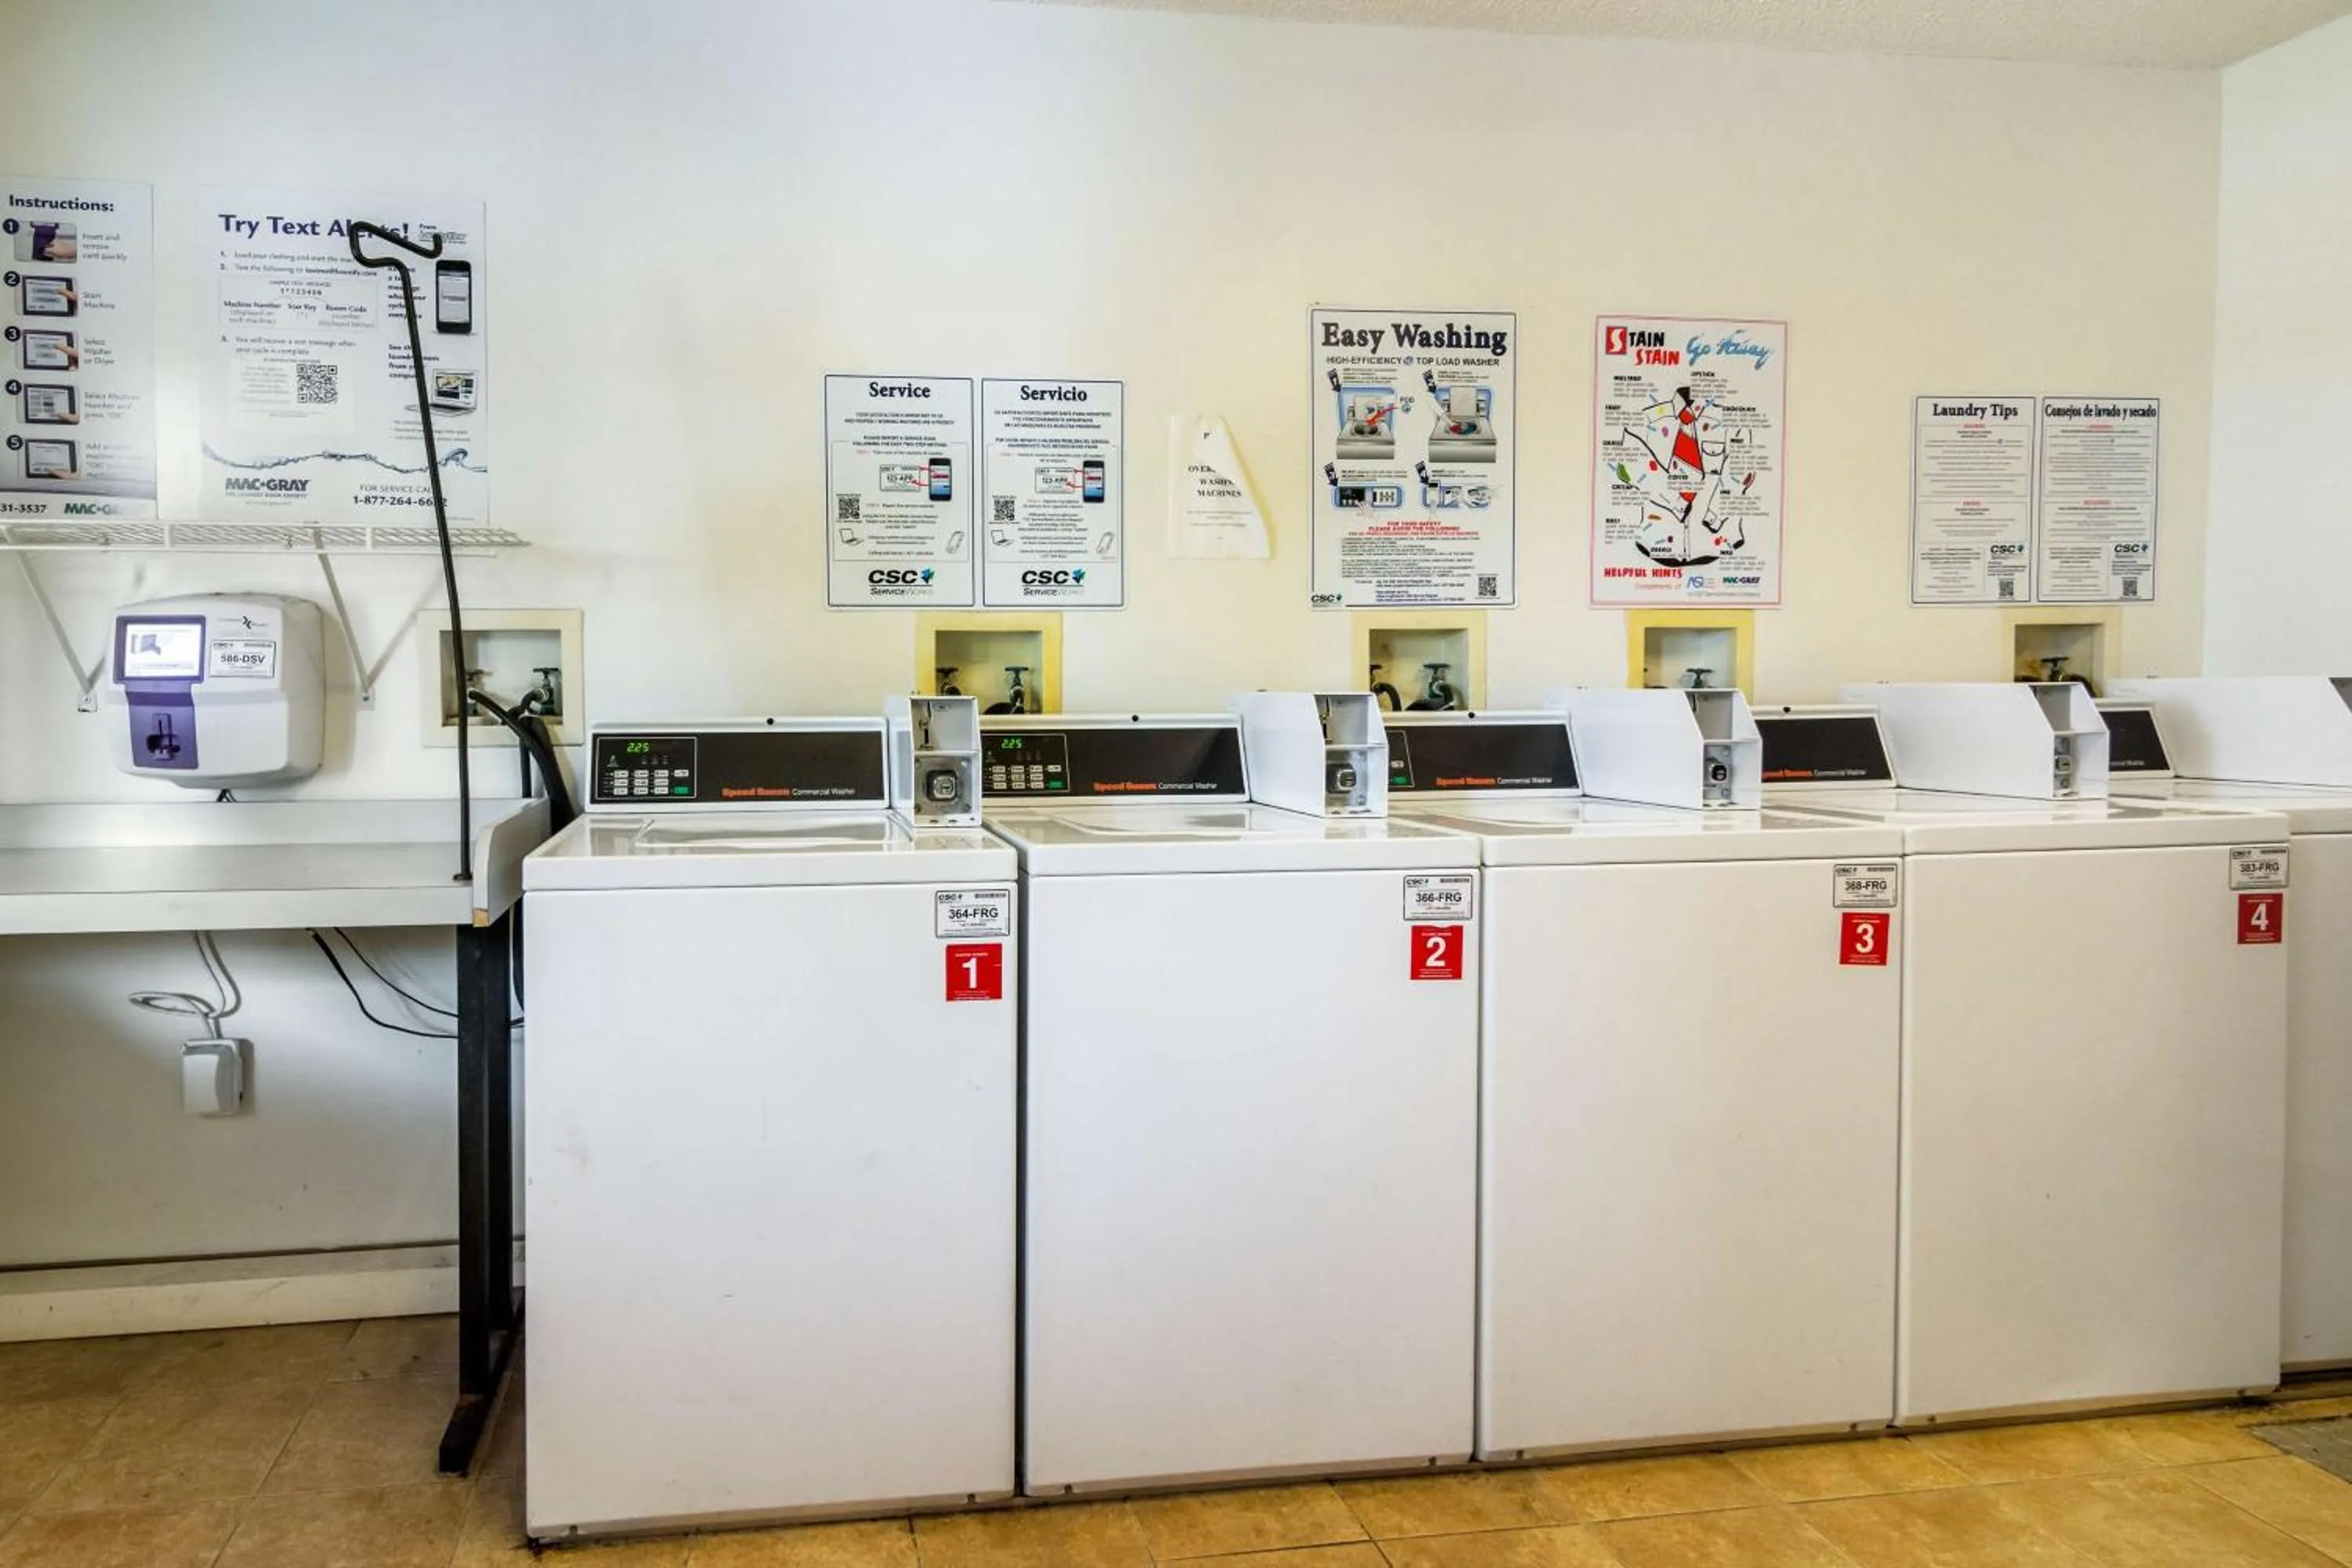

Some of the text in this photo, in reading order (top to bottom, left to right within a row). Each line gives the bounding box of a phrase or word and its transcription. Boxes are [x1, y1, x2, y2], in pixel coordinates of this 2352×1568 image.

[9, 194, 114, 212] Instructions:
[219, 214, 260, 238] Try
[267, 216, 320, 236] Text
[1321, 322, 1508, 357] Easy Washing
[1327, 356, 1402, 365] HIGH-EFFICIENCY
[1417, 357, 1434, 365] TOP
[1436, 358, 1460, 366] LOAD
[1634, 348, 1680, 366] STAIN
[869, 382, 931, 398] Service
[1020, 385, 1087, 401] Servicio
[1933, 404, 2018, 419] Laundry Tips
[2045, 405, 2156, 420] Consejos de lavado y secado
[353, 495, 448, 507] 1-877-264-662
[1991, 545, 2016, 554] CSC
[2114, 544, 2140, 553] CSC
[869, 569, 918, 584] CSC
[1022, 570, 1069, 584] CSC
[1604, 568, 1682, 579] HELPFUL HINTS
[1311, 593, 1335, 603] CSC
[220, 654, 266, 663] 586-DSV
[791, 787, 829, 796] Commercial
[1845, 880, 1887, 891] 368-FRG
[1415, 892, 1462, 903] 366-FRG
[949, 908, 998, 919] 364-FRG
[2251, 902, 2269, 931] 4
[1856, 923, 1874, 953] 3
[1425, 936, 1446, 967] 2
[962, 957, 978, 989] 1
